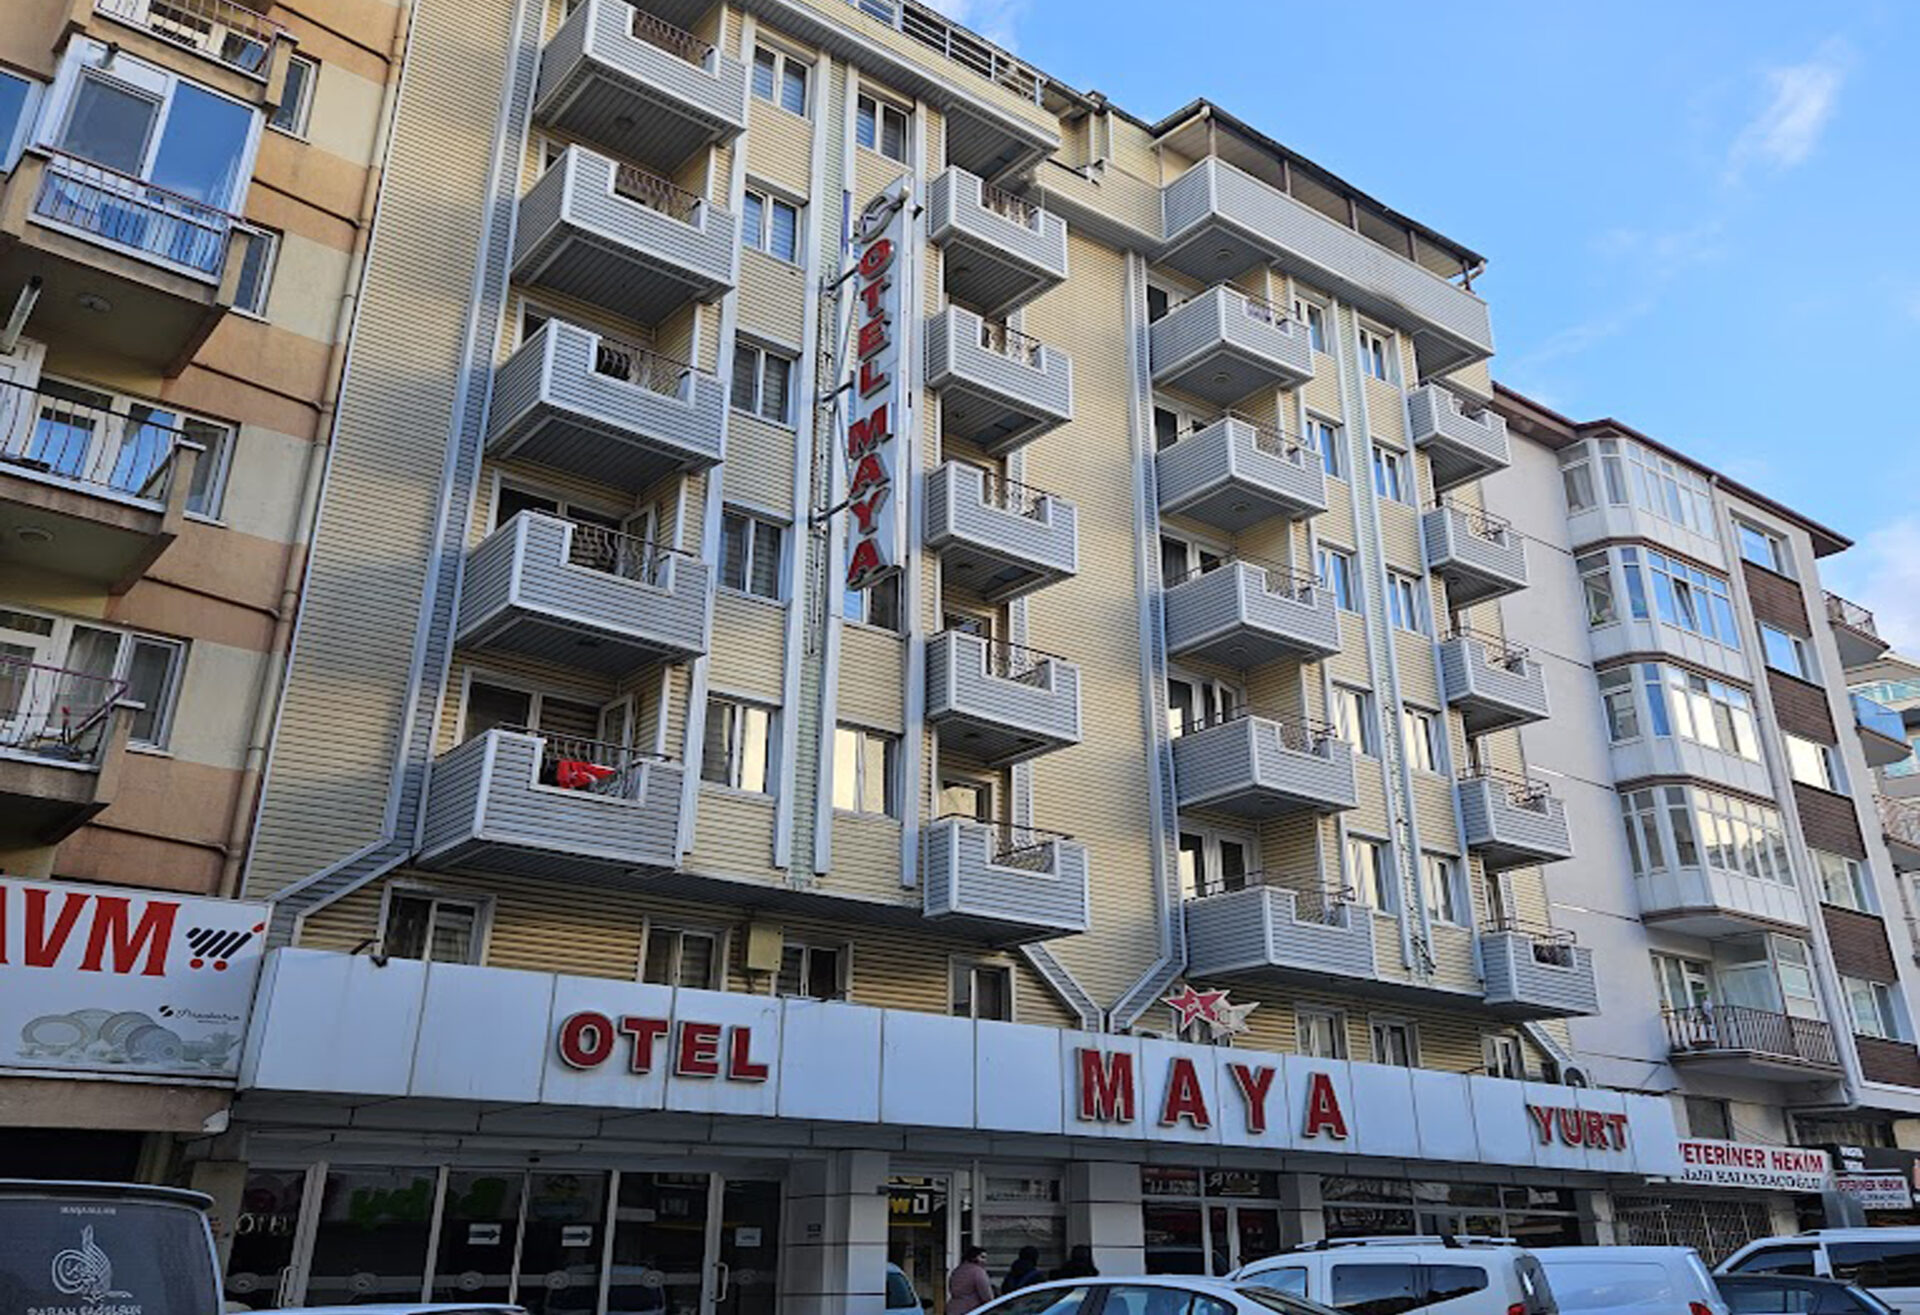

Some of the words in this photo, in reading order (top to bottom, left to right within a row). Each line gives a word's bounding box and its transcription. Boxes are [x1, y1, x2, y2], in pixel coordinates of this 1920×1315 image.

[857, 238, 896, 399] OTEL
[847, 402, 894, 592] MAYA
[0, 885, 181, 977] VM
[559, 1010, 769, 1083] OTEL
[1075, 1047, 1349, 1140] MAYA
[1526, 1103, 1629, 1151] YURT
[1678, 1142, 1767, 1169] ETERİNER
